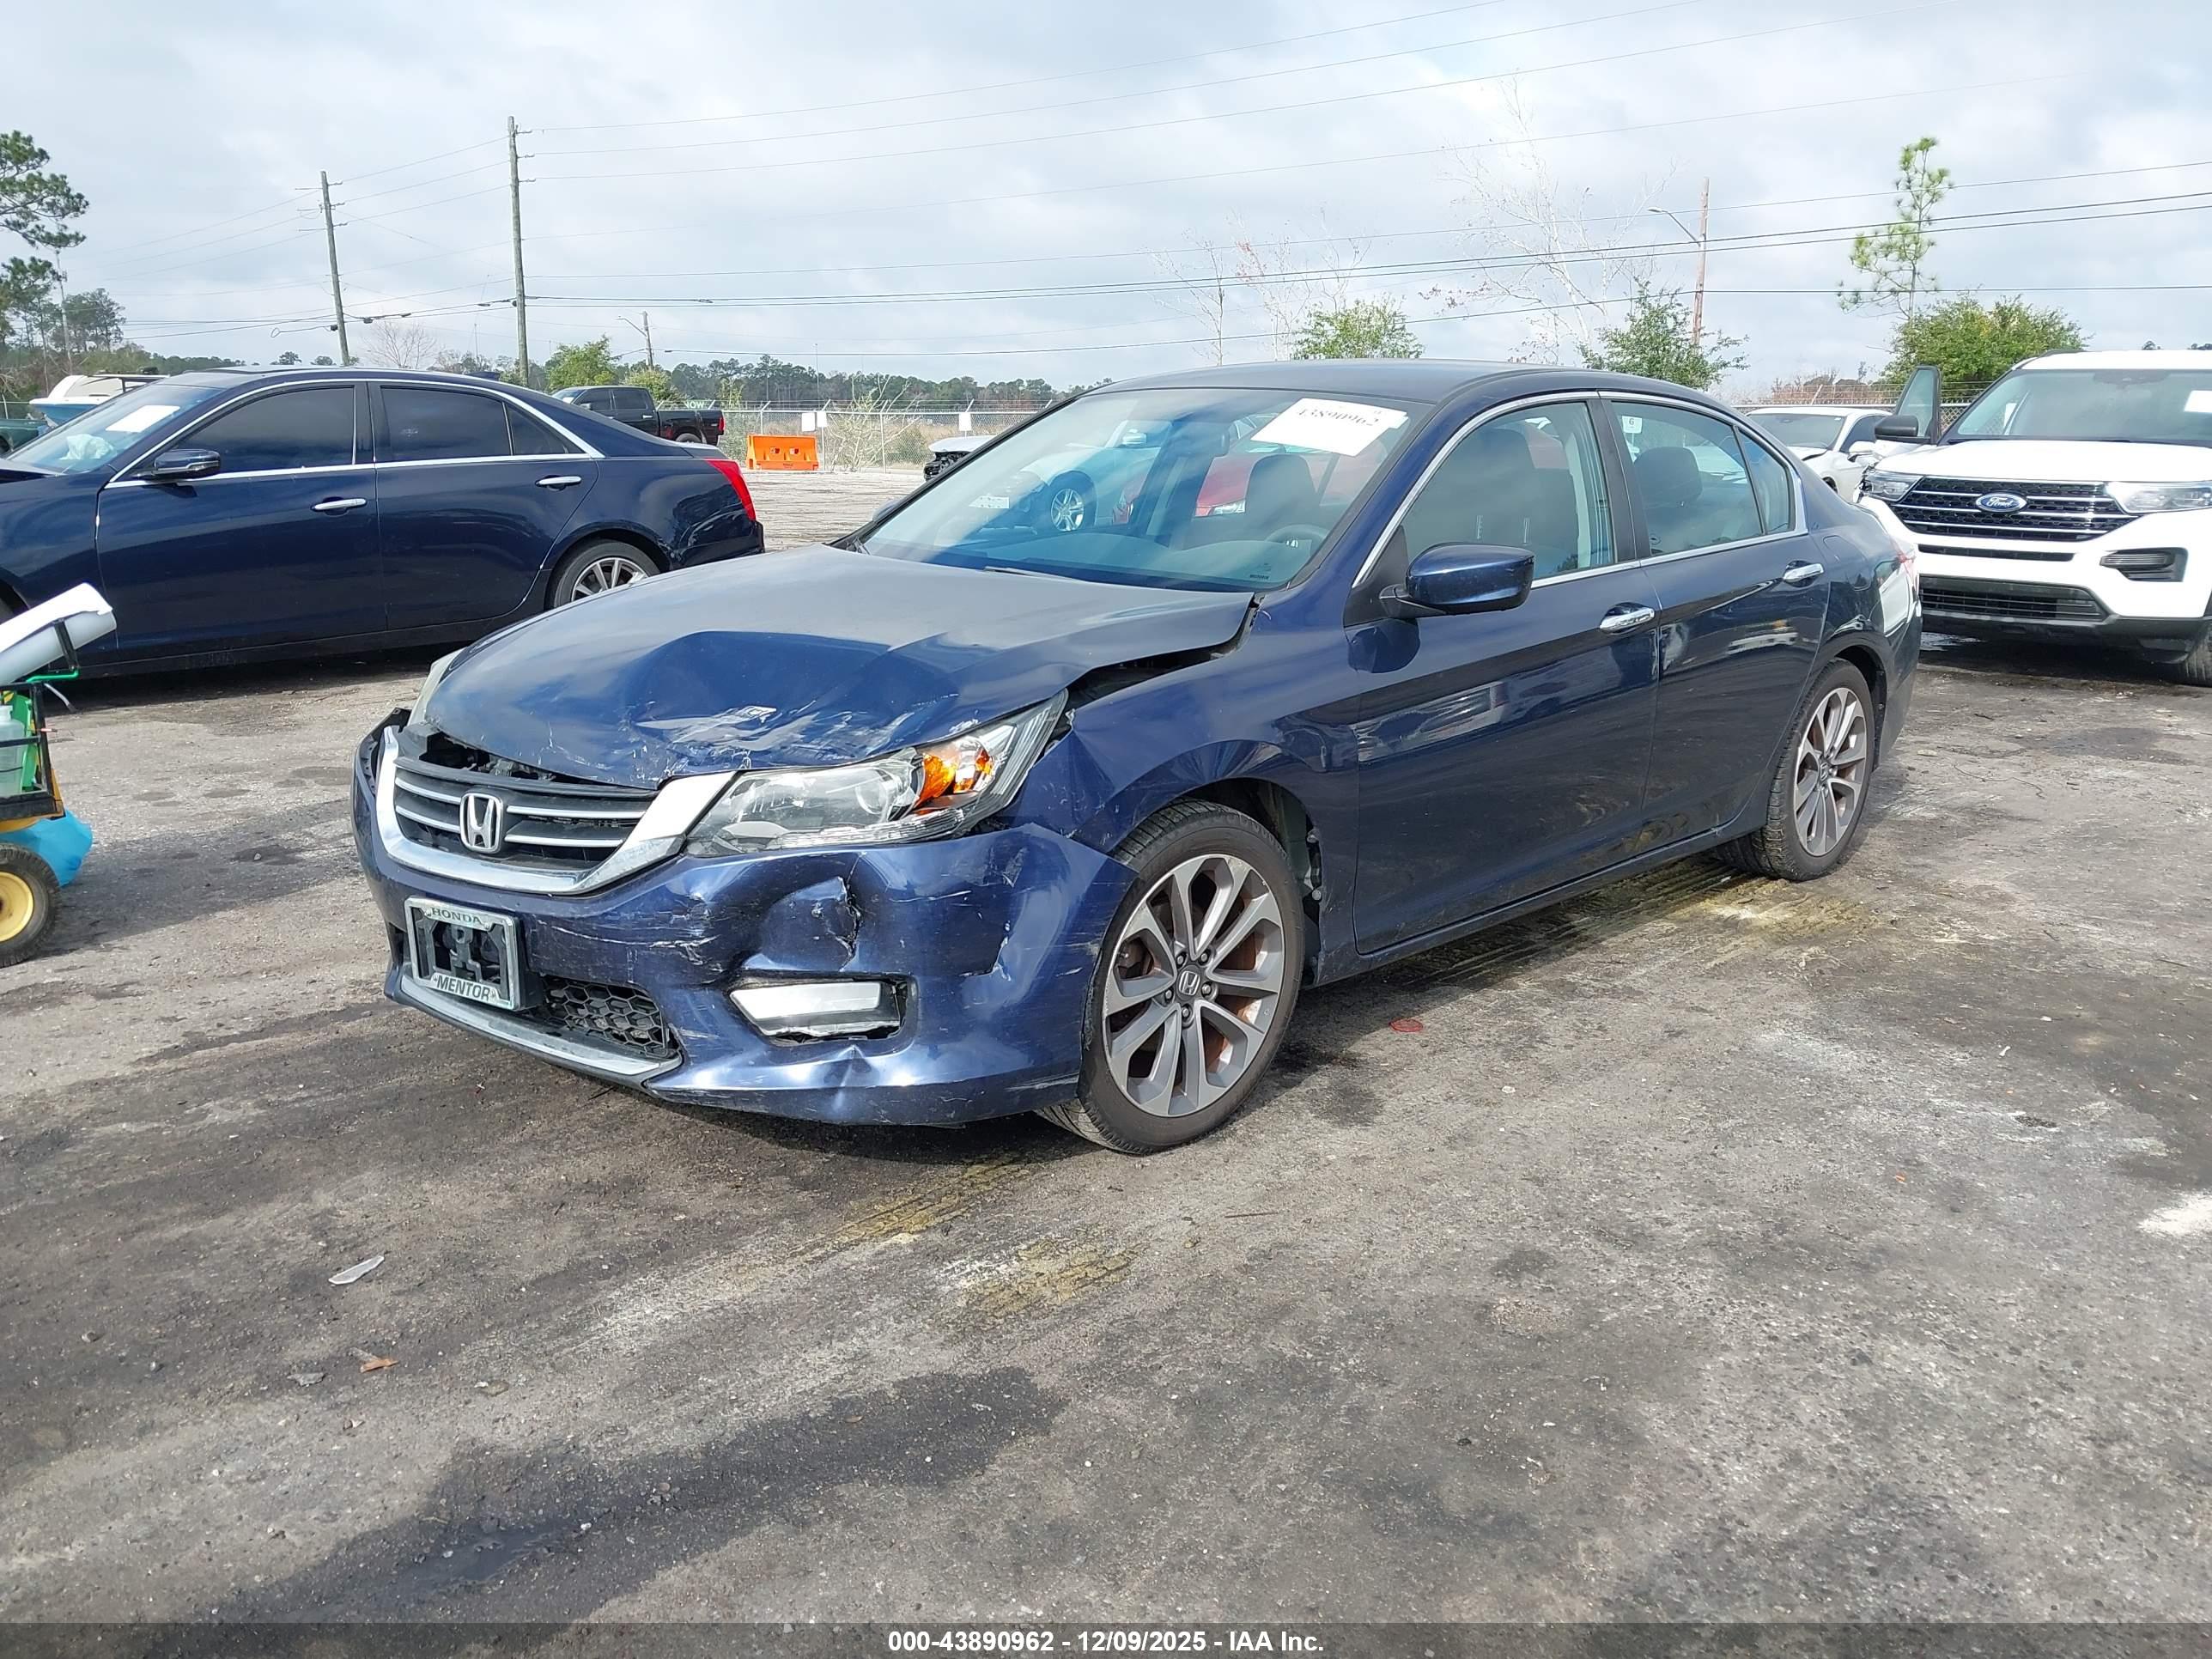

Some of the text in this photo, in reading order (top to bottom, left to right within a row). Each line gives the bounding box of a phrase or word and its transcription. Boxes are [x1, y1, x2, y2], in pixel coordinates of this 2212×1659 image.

[1986, 496, 2015, 507] Ford
[431, 907, 485, 926] HONDA
[436, 975, 492, 1001] MENTOR
